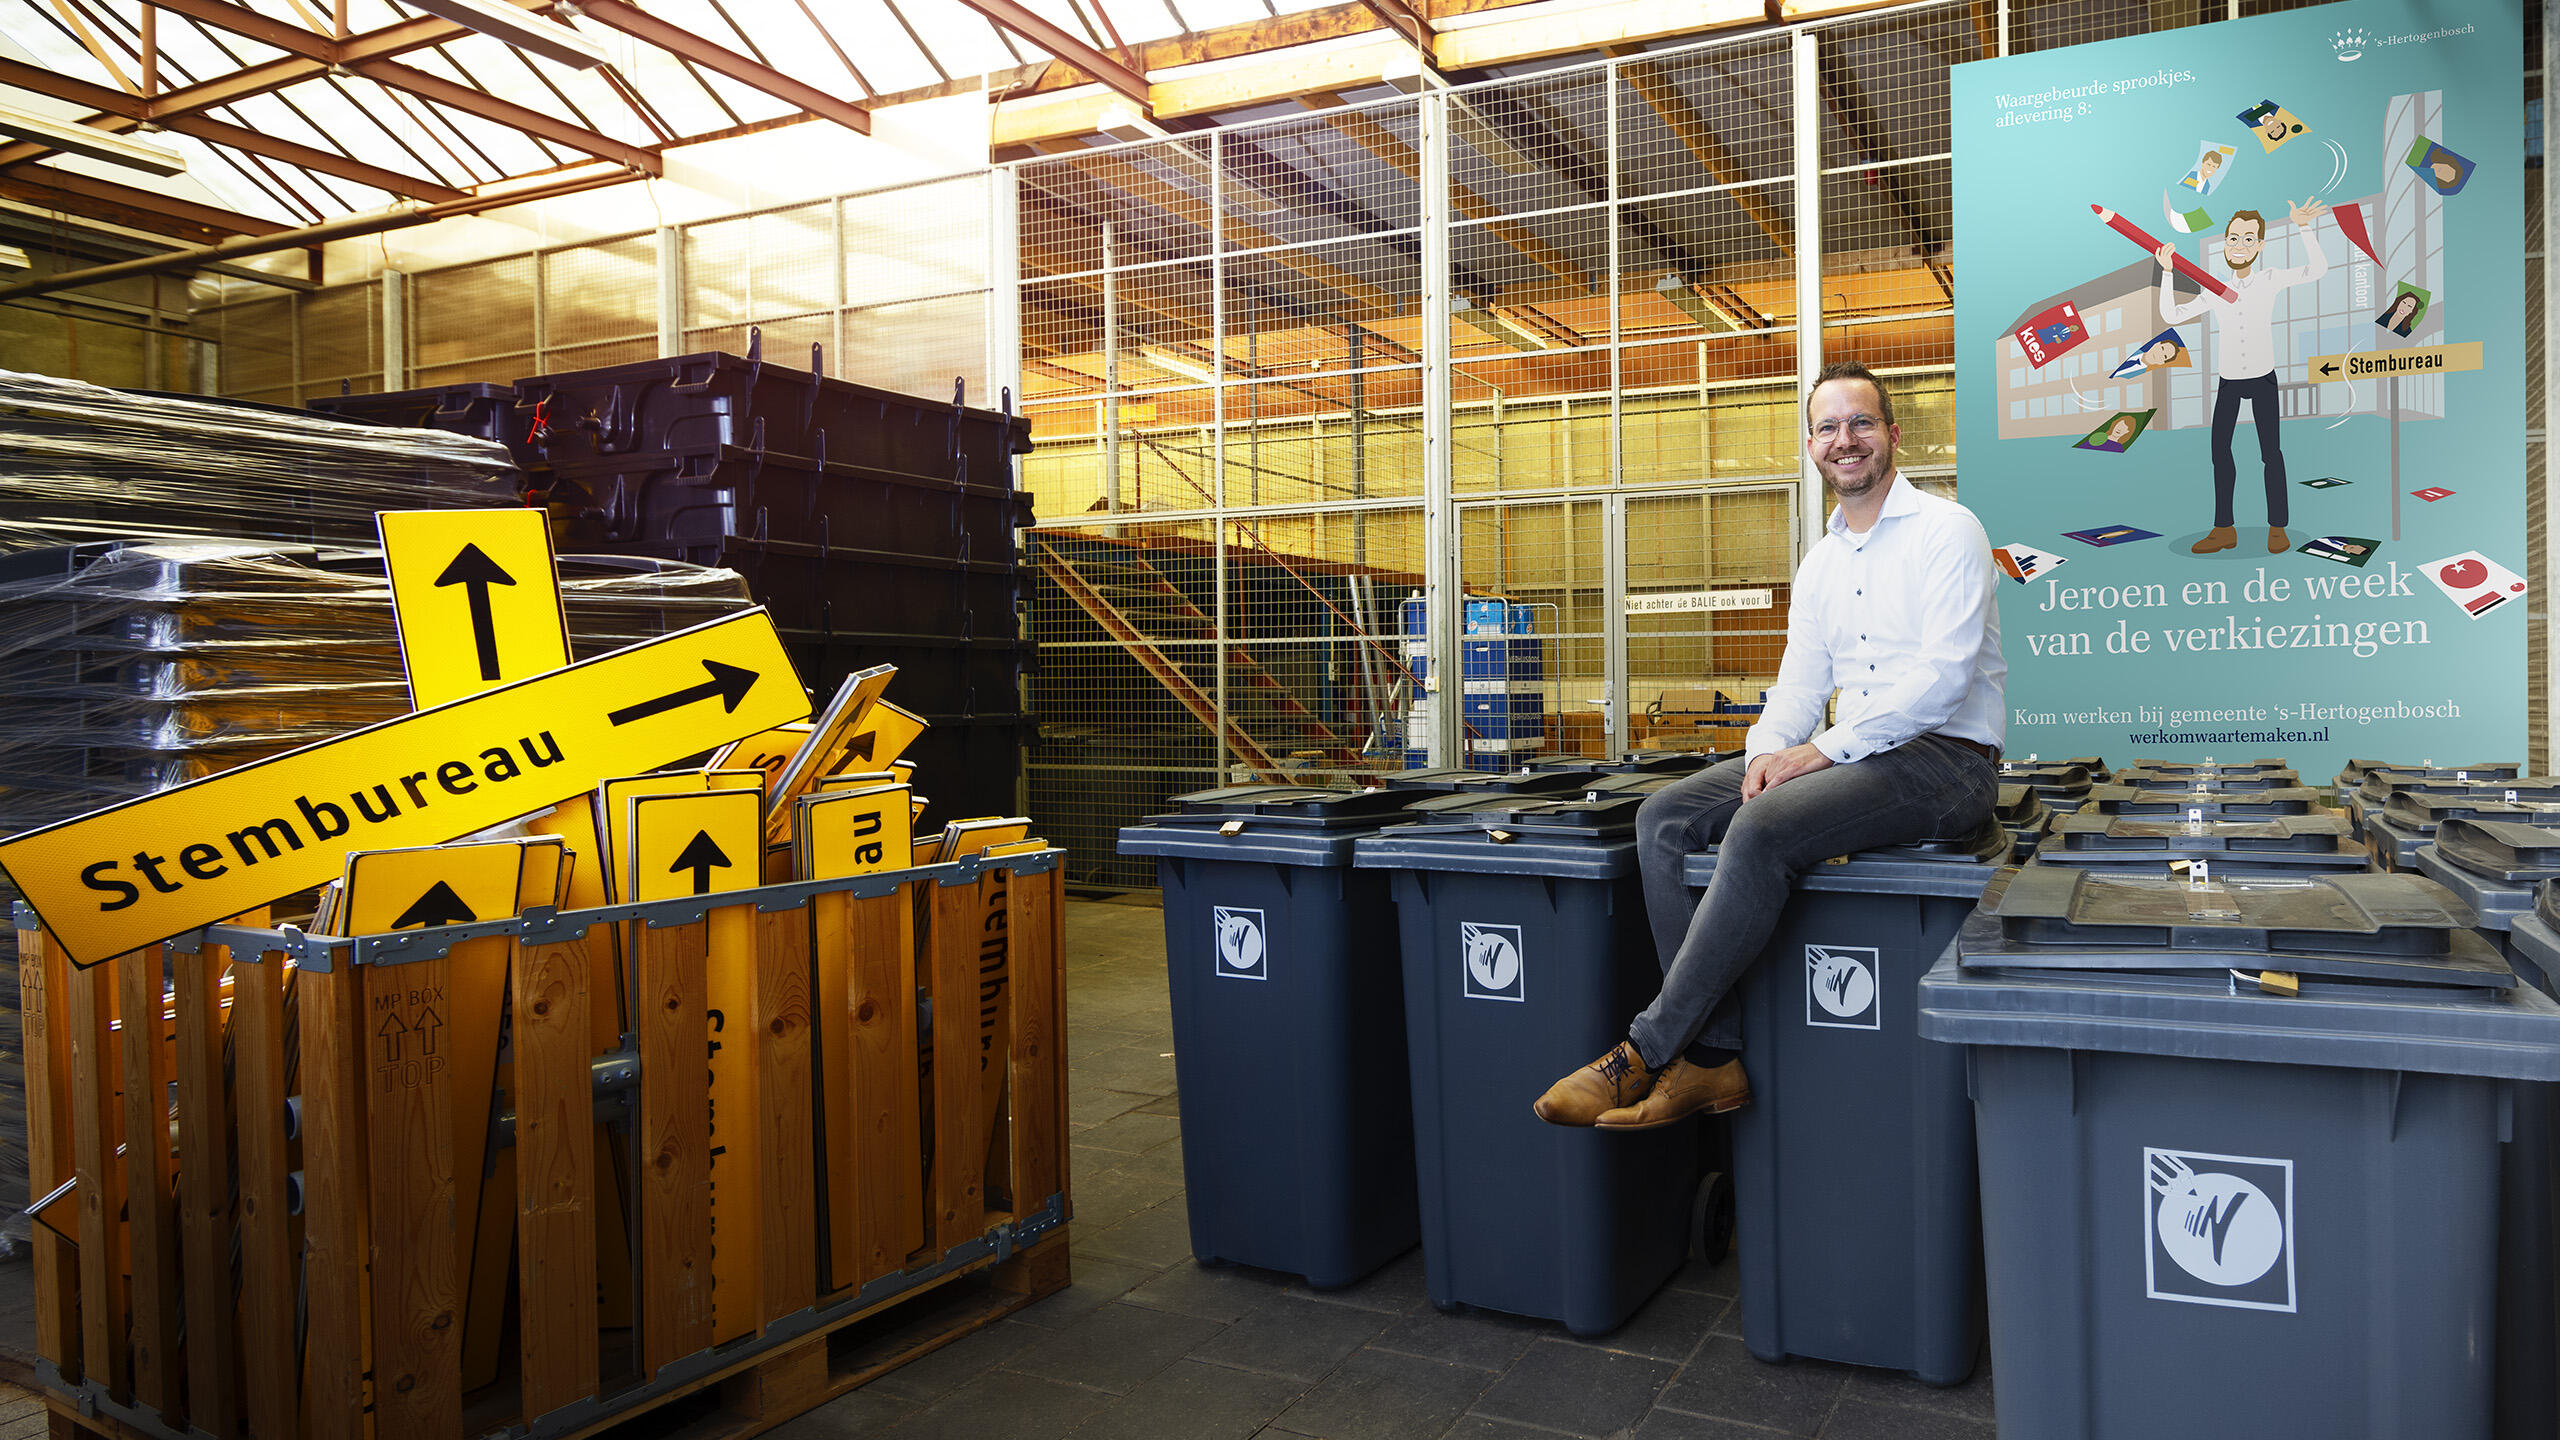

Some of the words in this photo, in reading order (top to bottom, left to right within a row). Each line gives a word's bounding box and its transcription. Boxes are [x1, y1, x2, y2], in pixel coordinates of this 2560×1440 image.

[1994, 80, 2108, 110] Waargebeurde
[2112, 69, 2196, 95] sprookjes,
[1994, 105, 2073, 128] aflevering
[2077, 101, 2092, 116] 8:
[2349, 354, 2443, 375] Stembureau
[2039, 579, 2169, 612] Jeroen
[2181, 579, 2230, 606] en
[2243, 567, 2291, 603] de
[2304, 561, 2415, 600] week
[1625, 599, 1643, 611] Niet
[1646, 598, 1673, 610] achter
[1691, 596, 1718, 608] BALIE
[1720, 596, 1737, 607] ook
[1741, 596, 1760, 606] voor
[2026, 631, 2093, 657] van
[2105, 619, 2151, 654] de
[2162, 614, 2432, 658] verkiezingen
[2014, 708, 2057, 726] Kom
[2063, 707, 2133, 725] werken
[2139, 706, 2164, 728] bij
[2170, 706, 2267, 728] gemeente
[2129, 726, 2330, 744] werkomwaartemaken.nl
[80, 729, 566, 913] Stembureau
[375, 993, 401, 1012] MP
[409, 985, 444, 1007] BOX
[376, 1055, 445, 1093] TOP
